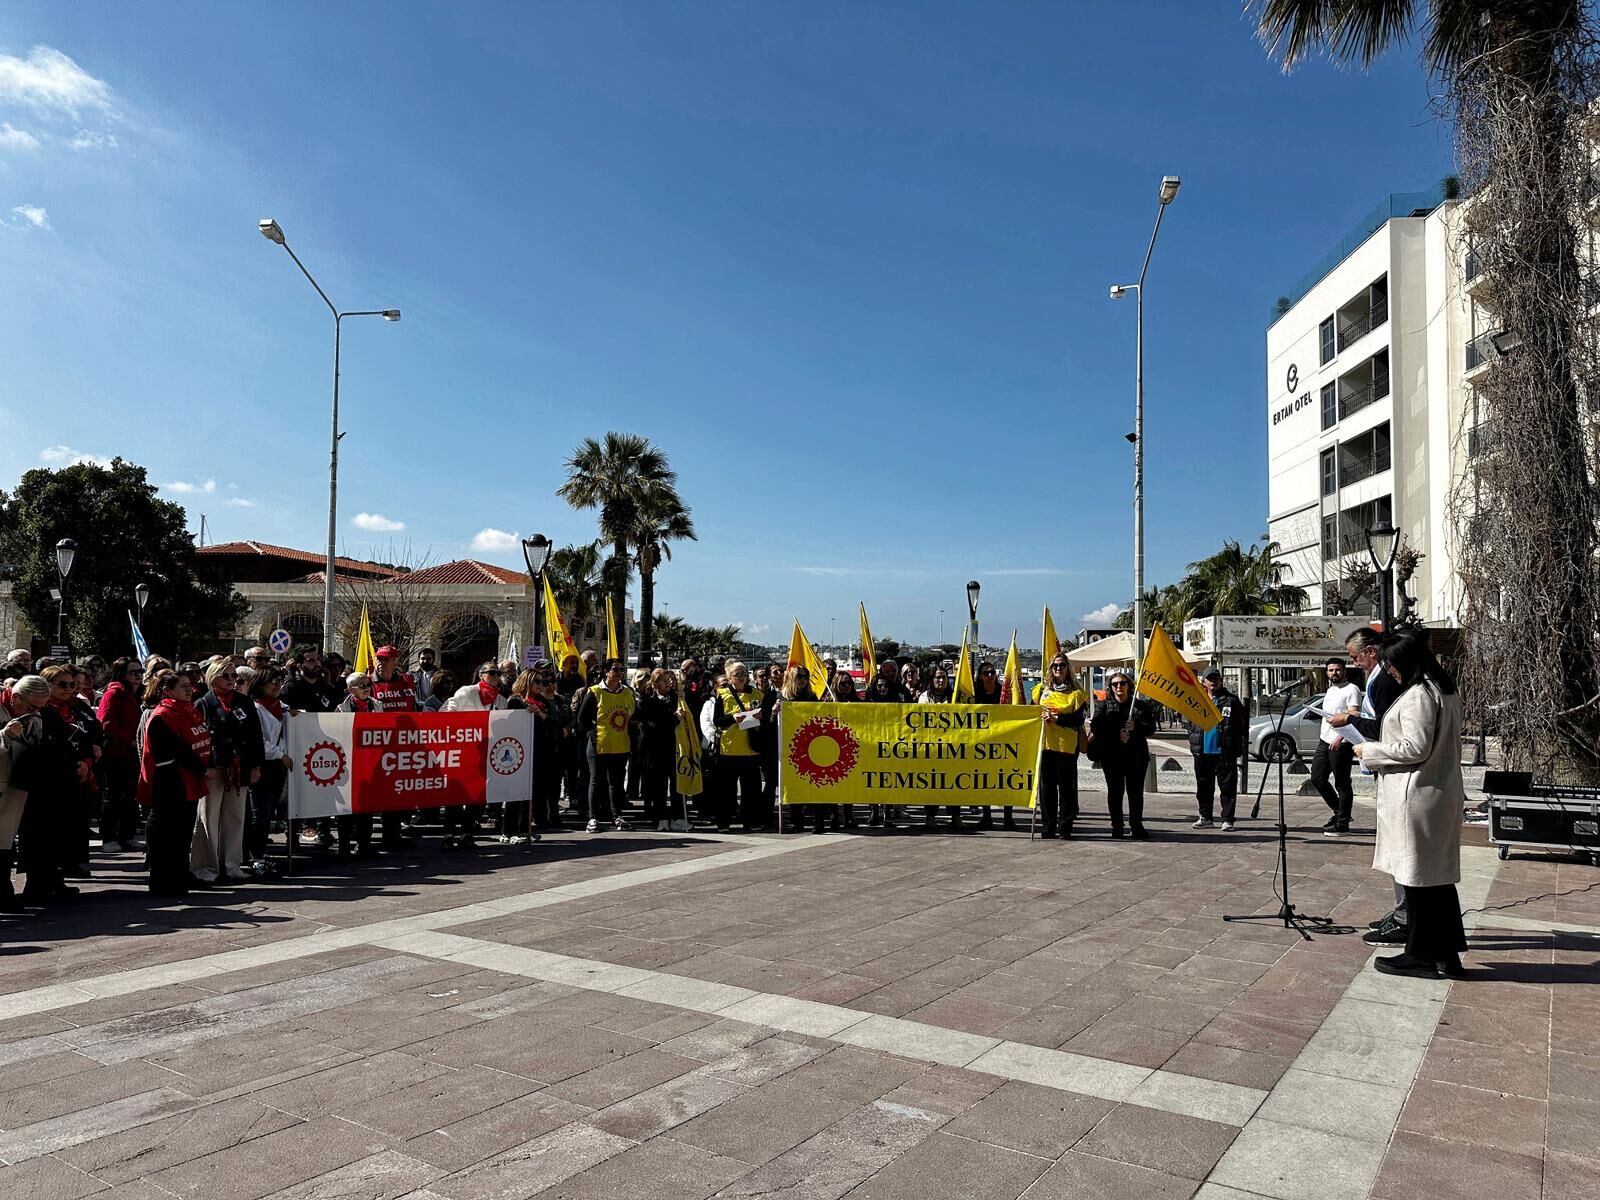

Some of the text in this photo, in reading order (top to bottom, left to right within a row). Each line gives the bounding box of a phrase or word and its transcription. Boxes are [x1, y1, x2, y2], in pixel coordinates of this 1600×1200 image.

[1273, 391, 1313, 426] ERTAN OTEL
[1141, 669, 1210, 718] EĞİTİM SEN
[905, 711, 989, 732] ÇEŞME
[362, 726, 482, 746] DEV EMEKLİ-SEN
[877, 737, 1020, 760] EĞİTİM SEN
[312, 756, 338, 769] DİSK
[381, 749, 462, 776] ÇEŞME
[394, 774, 448, 794] ŞUBESİ
[862, 768, 1034, 792] TEMSİLCİLİĞİ
